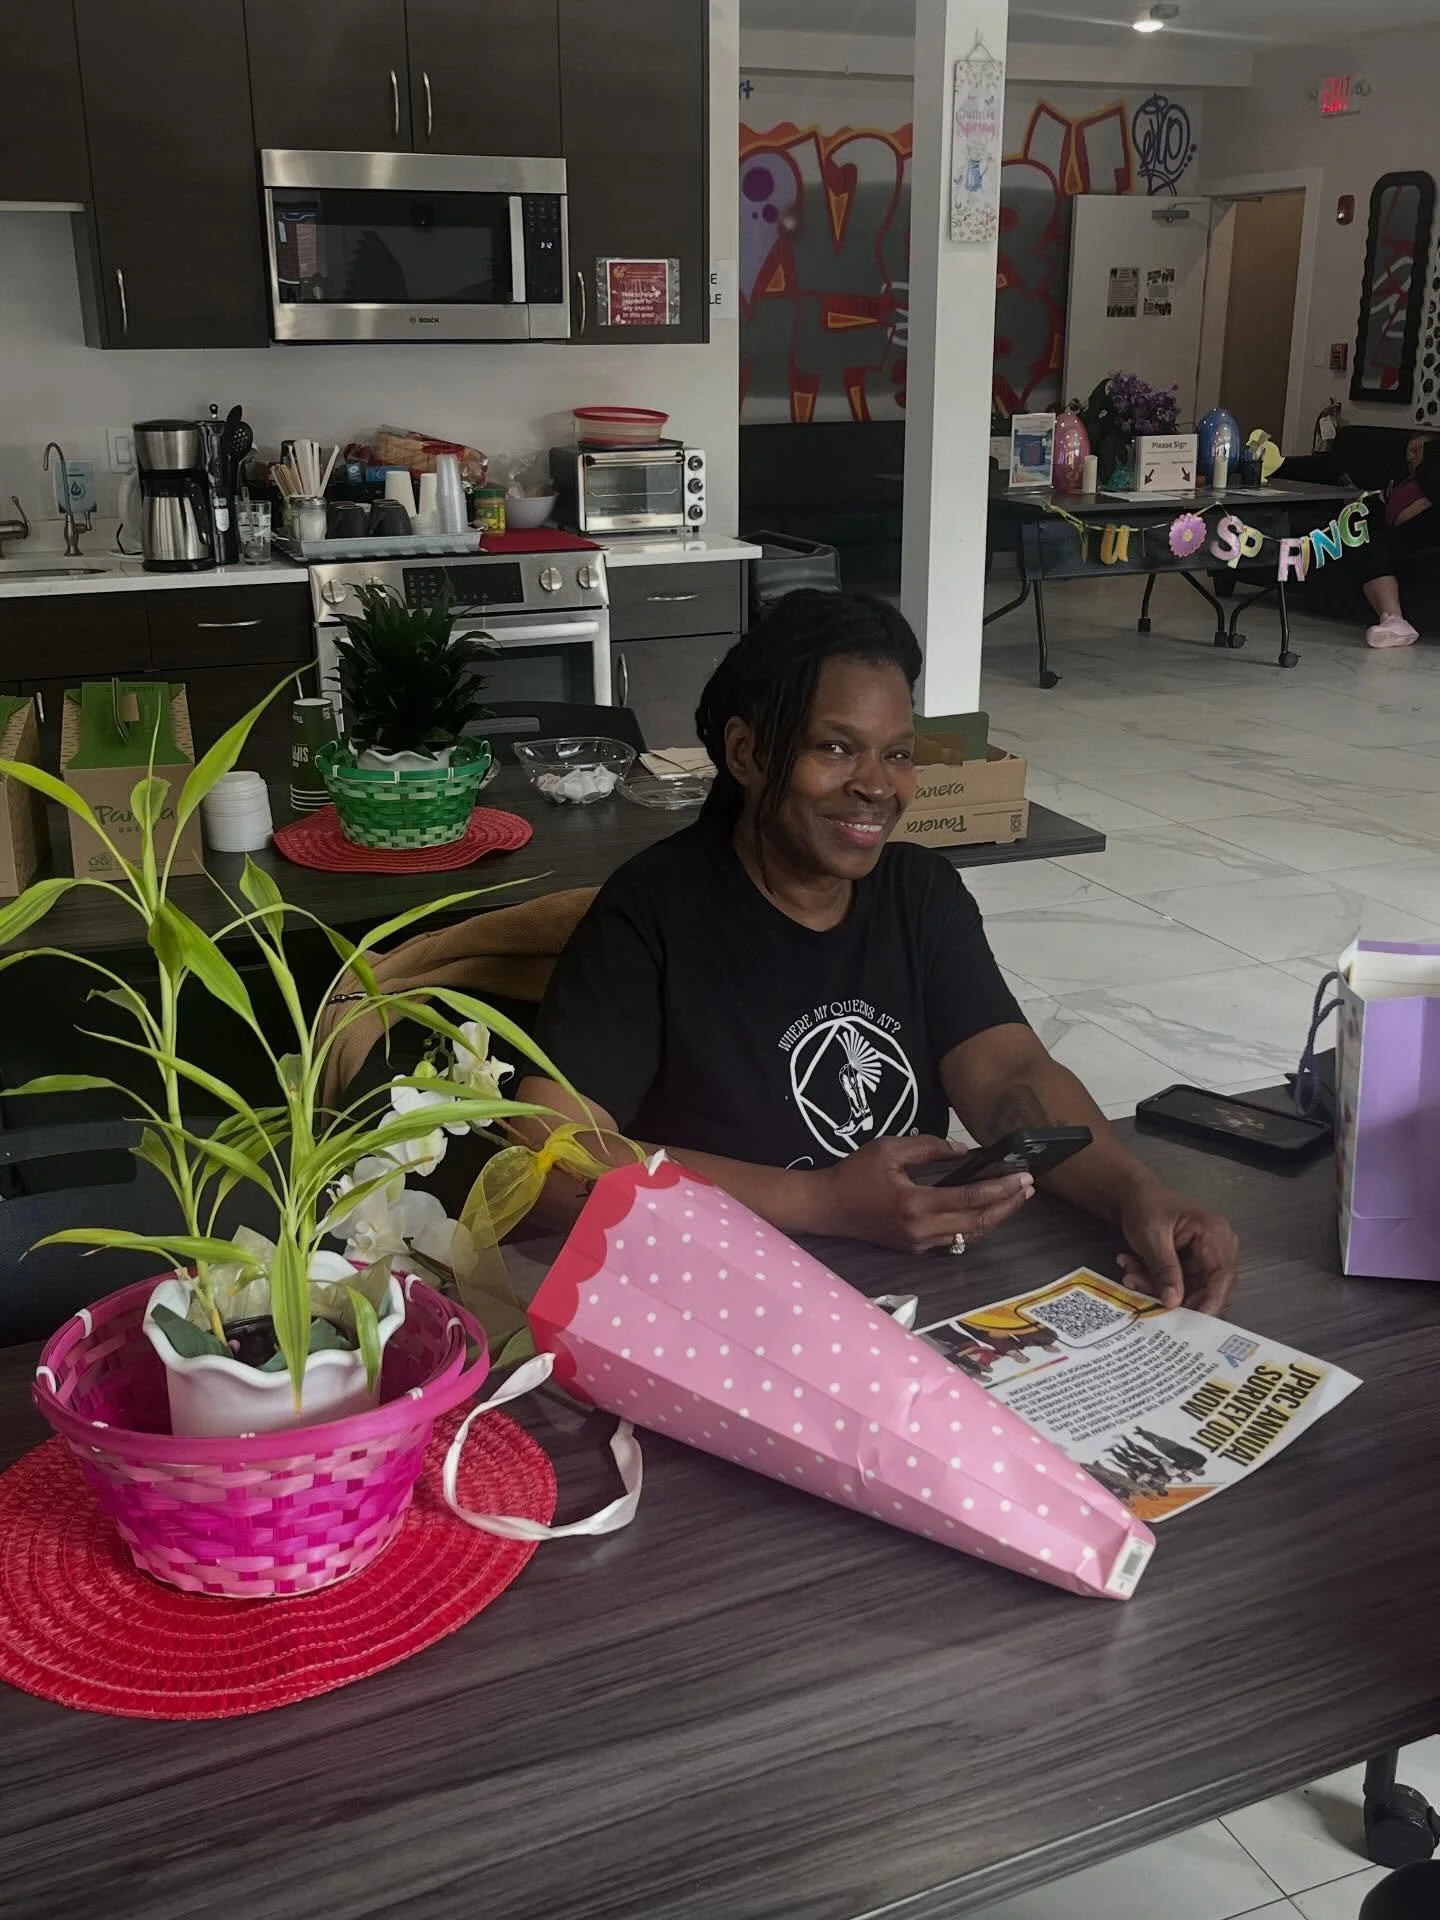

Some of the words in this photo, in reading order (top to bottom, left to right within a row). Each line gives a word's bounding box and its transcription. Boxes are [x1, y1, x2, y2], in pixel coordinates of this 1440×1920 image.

[1152, 441, 1172, 449] Please
[1173, 440, 1187, 450] Sign
[914, 782, 965, 800] anera
[904, 815, 968, 834] Panera
[778, 1014, 813, 1052] WHERE
[813, 1004, 828, 1021] MY
[830, 999, 875, 1020] QUEENS
[877, 1013, 901, 1034] AT?
[1180, 1382, 1230, 1421] NOW
[1217, 1365, 1282, 1428] SURVEY
[1271, 1363, 1321, 1409] JPRC
[1190, 1420, 1235, 1453] OUT
[1217, 1404, 1290, 1467] ANNUAL
